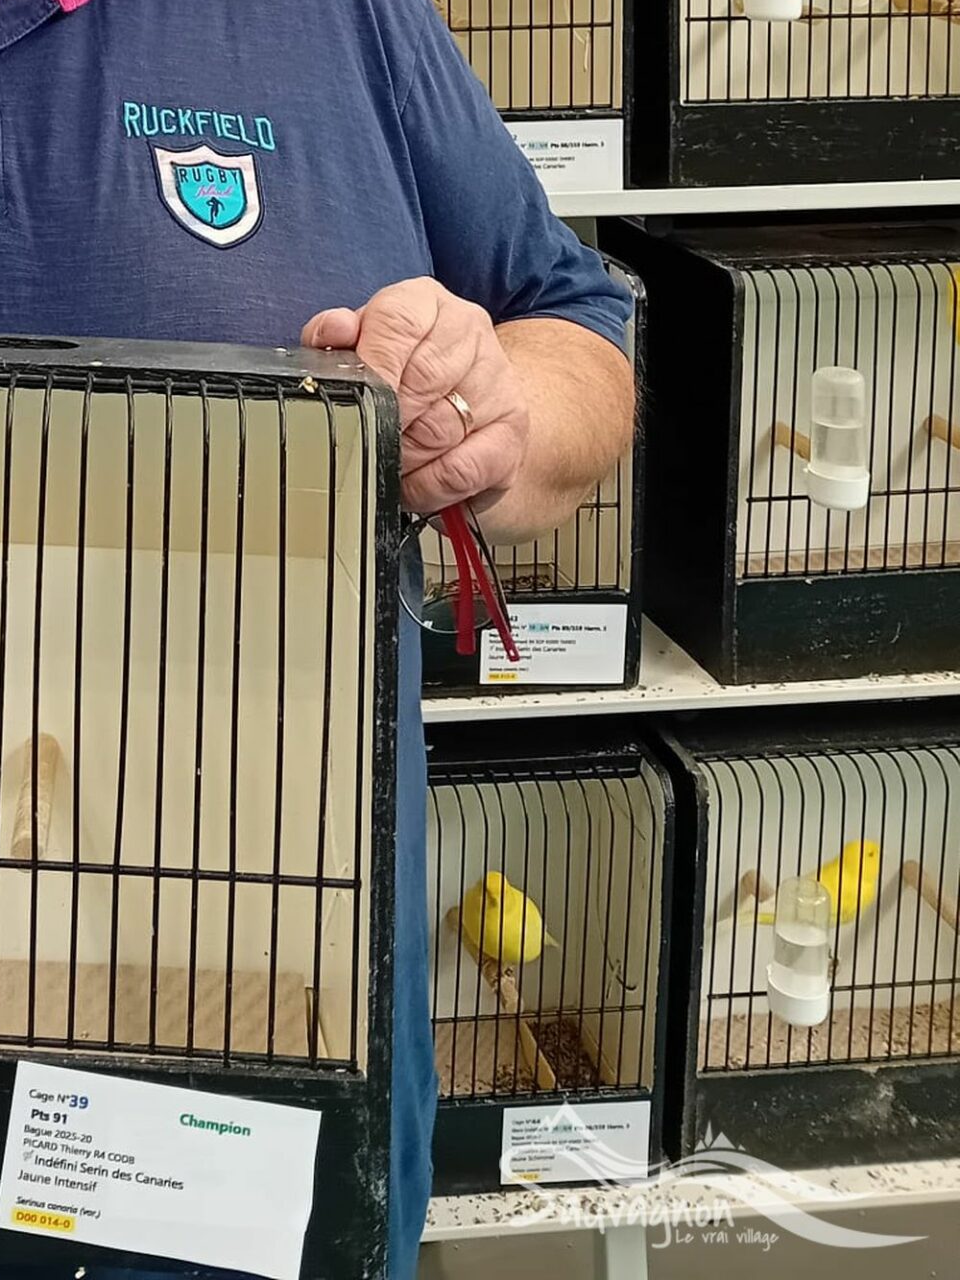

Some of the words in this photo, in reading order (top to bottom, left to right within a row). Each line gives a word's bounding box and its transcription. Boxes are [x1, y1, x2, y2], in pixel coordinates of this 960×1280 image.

[123, 100, 276, 151] RUCKFIELD
[180, 167, 239, 185] RUGBY
[29, 1088, 54, 1103] Cage
[30, 1108, 50, 1122] Pts
[53, 1112, 68, 1124] 91
[179, 1113, 251, 1137] Champion
[24, 1124, 52, 1136] Bague
[54, 1129, 92, 1144] 2025-20
[23, 1138, 58, 1152] PICARD
[60, 1143, 92, 1158] Thierry
[94, 1150, 105, 1158] R4
[18, 1170, 51, 1185] Jaune
[54, 1175, 98, 1192] Intensif
[34, 1154, 78, 1172] Indéfini
[80, 1162, 108, 1178] Serin
[112, 1168, 132, 1182] des
[135, 1172, 184, 1190] Canaries
[16, 1196, 46, 1208] Serinus
[47, 1202, 78, 1214] canaria
[40, 1214, 70, 1228] 014-0
